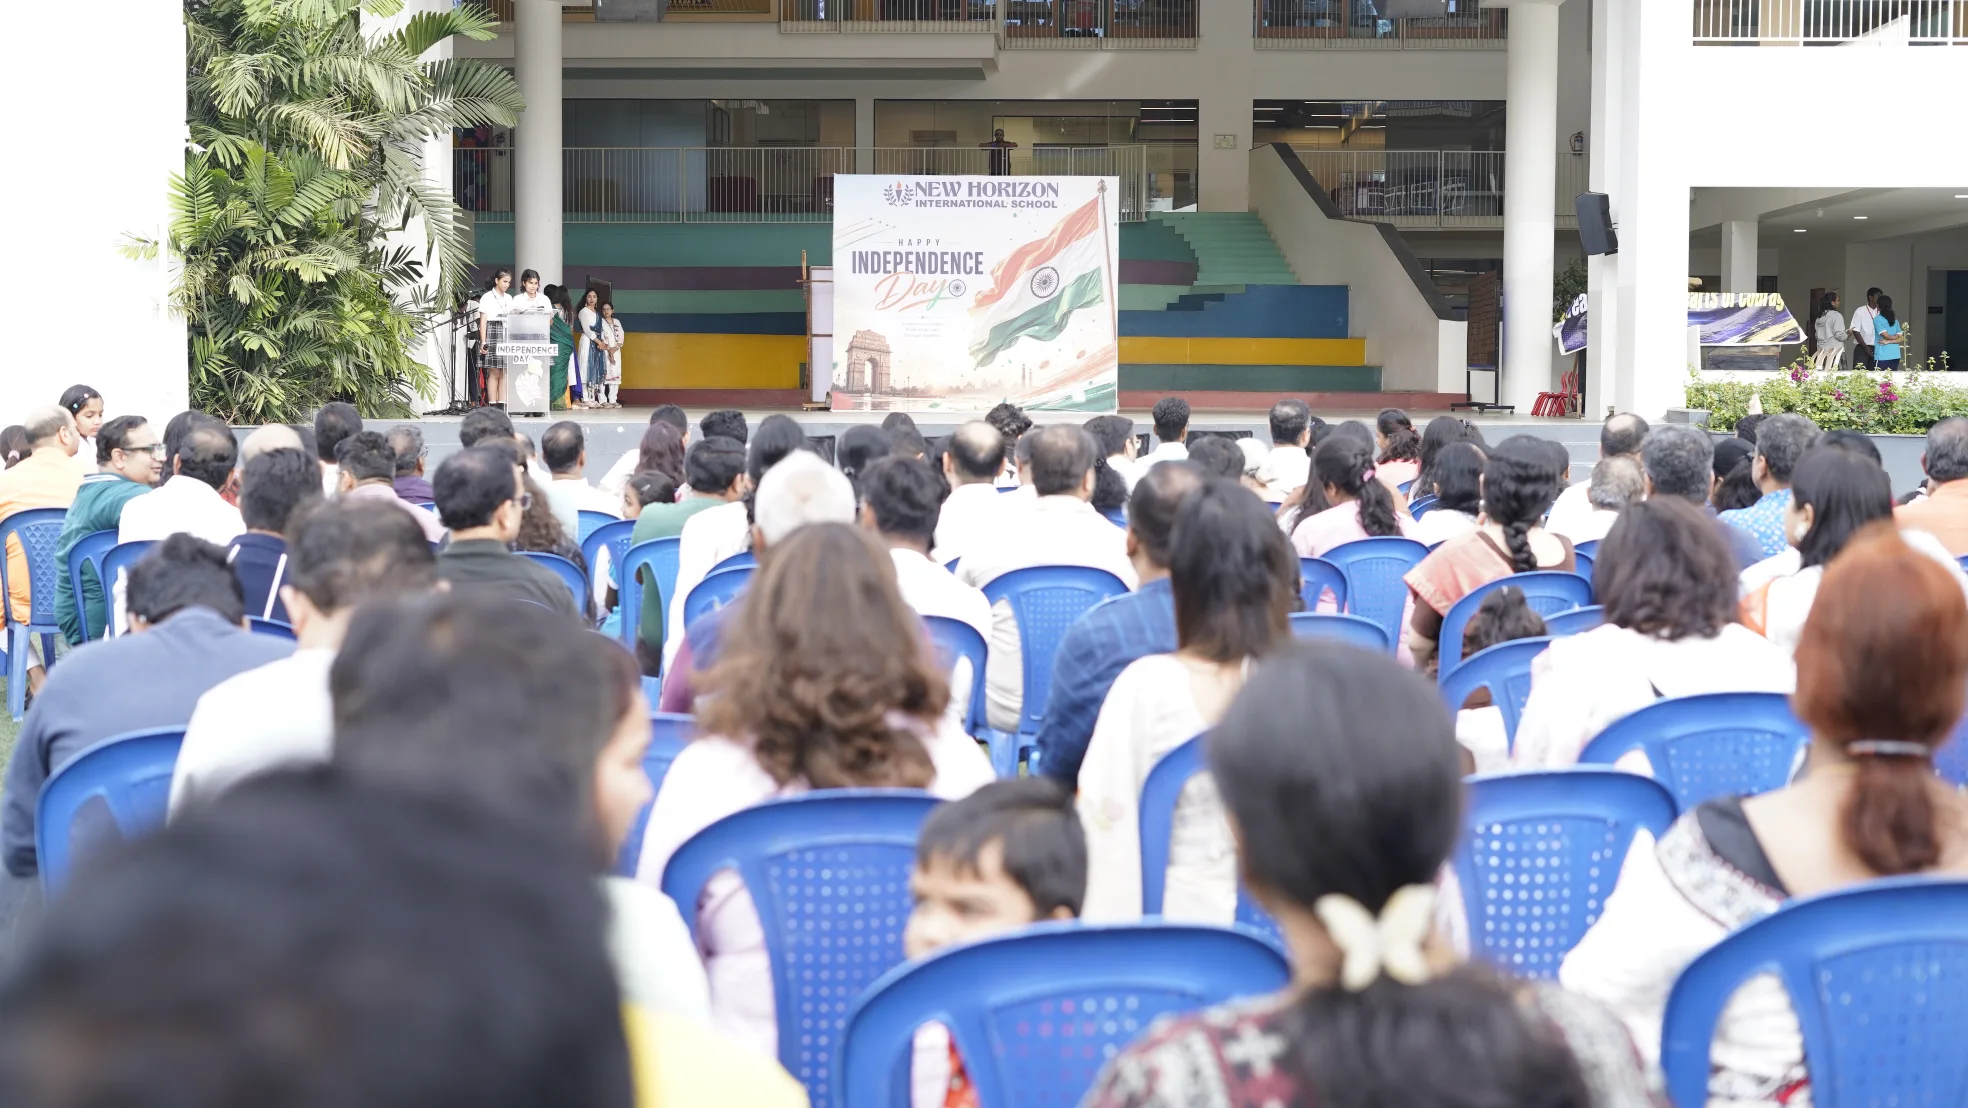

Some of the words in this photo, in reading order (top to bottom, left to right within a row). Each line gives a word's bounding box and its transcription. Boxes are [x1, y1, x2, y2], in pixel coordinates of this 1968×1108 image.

[915, 181, 962, 198] NEW
[967, 181, 1059, 198] HORIZON
[915, 199, 1008, 208] INTERNATIONAL
[1011, 200, 1058, 209] SCHOOL
[852, 250, 984, 275] INDEPENDENCE
[874, 271, 950, 312] Day
[498, 346, 557, 354] INDEPENDENCE
